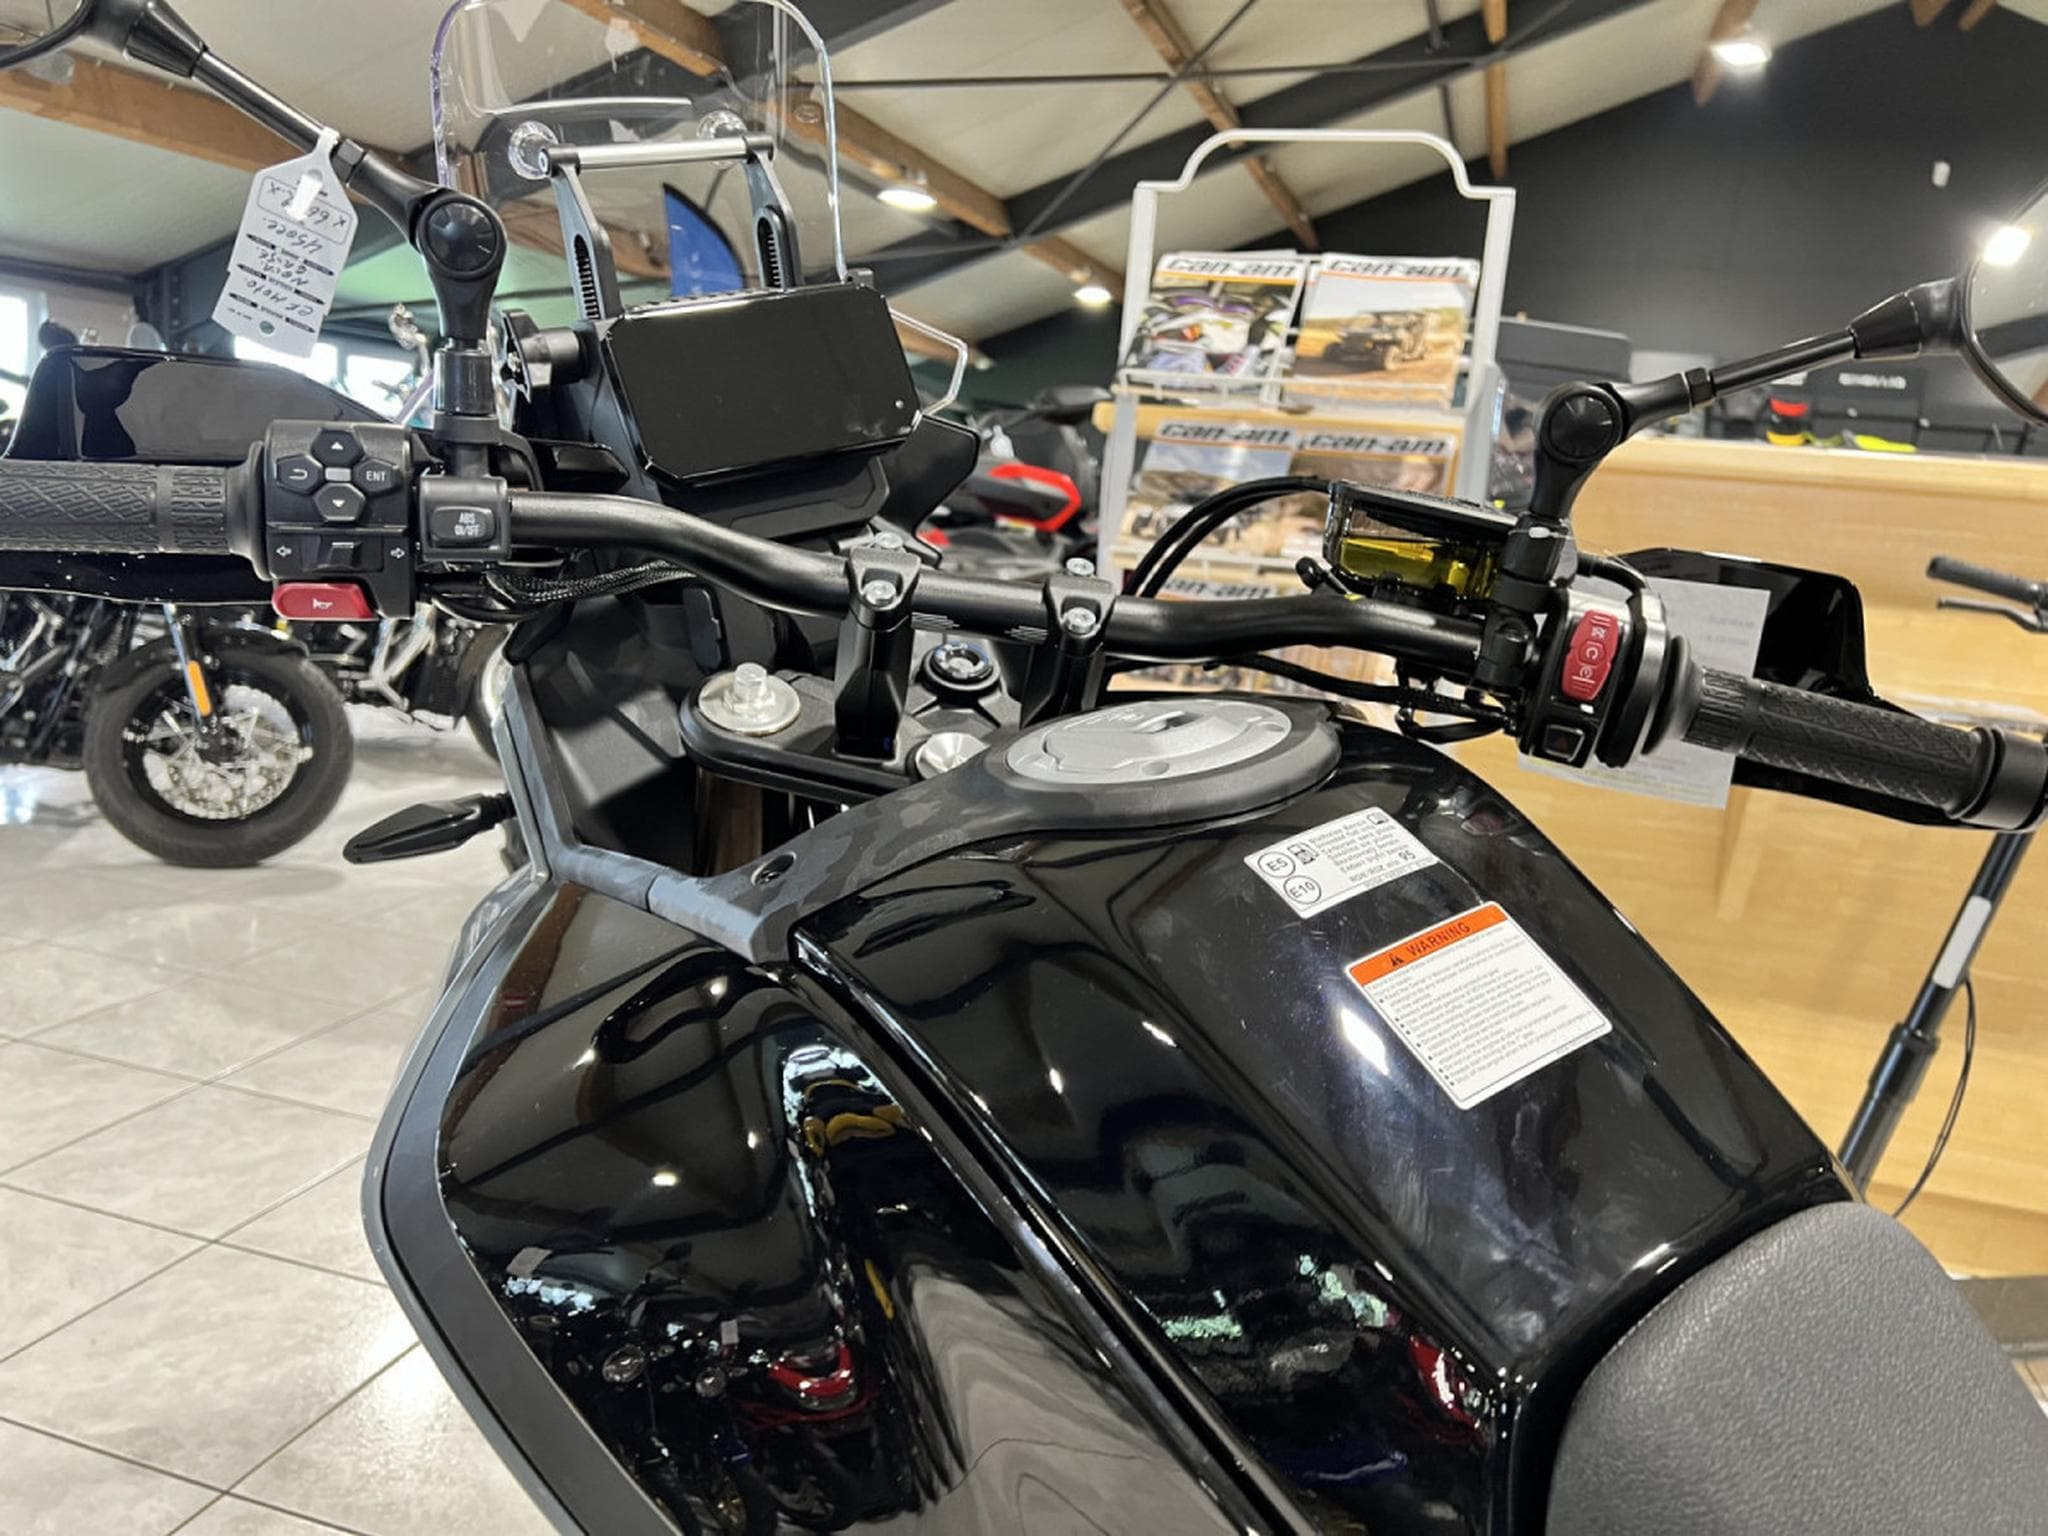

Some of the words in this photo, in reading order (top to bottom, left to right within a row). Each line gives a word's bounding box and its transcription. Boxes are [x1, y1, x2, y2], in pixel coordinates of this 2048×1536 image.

[1167, 258, 1298, 277] can-am
[1328, 258, 1466, 278] can-am
[1160, 423, 1291, 444] can-am
[1308, 432, 1447, 454] can-am
[365, 470, 386, 482] ENT
[1163, 578, 1272, 599] an-am
[1266, 856, 1288, 872] E5
[1290, 882, 1316, 898] E10
[1406, 921, 1471, 958] WARNING
